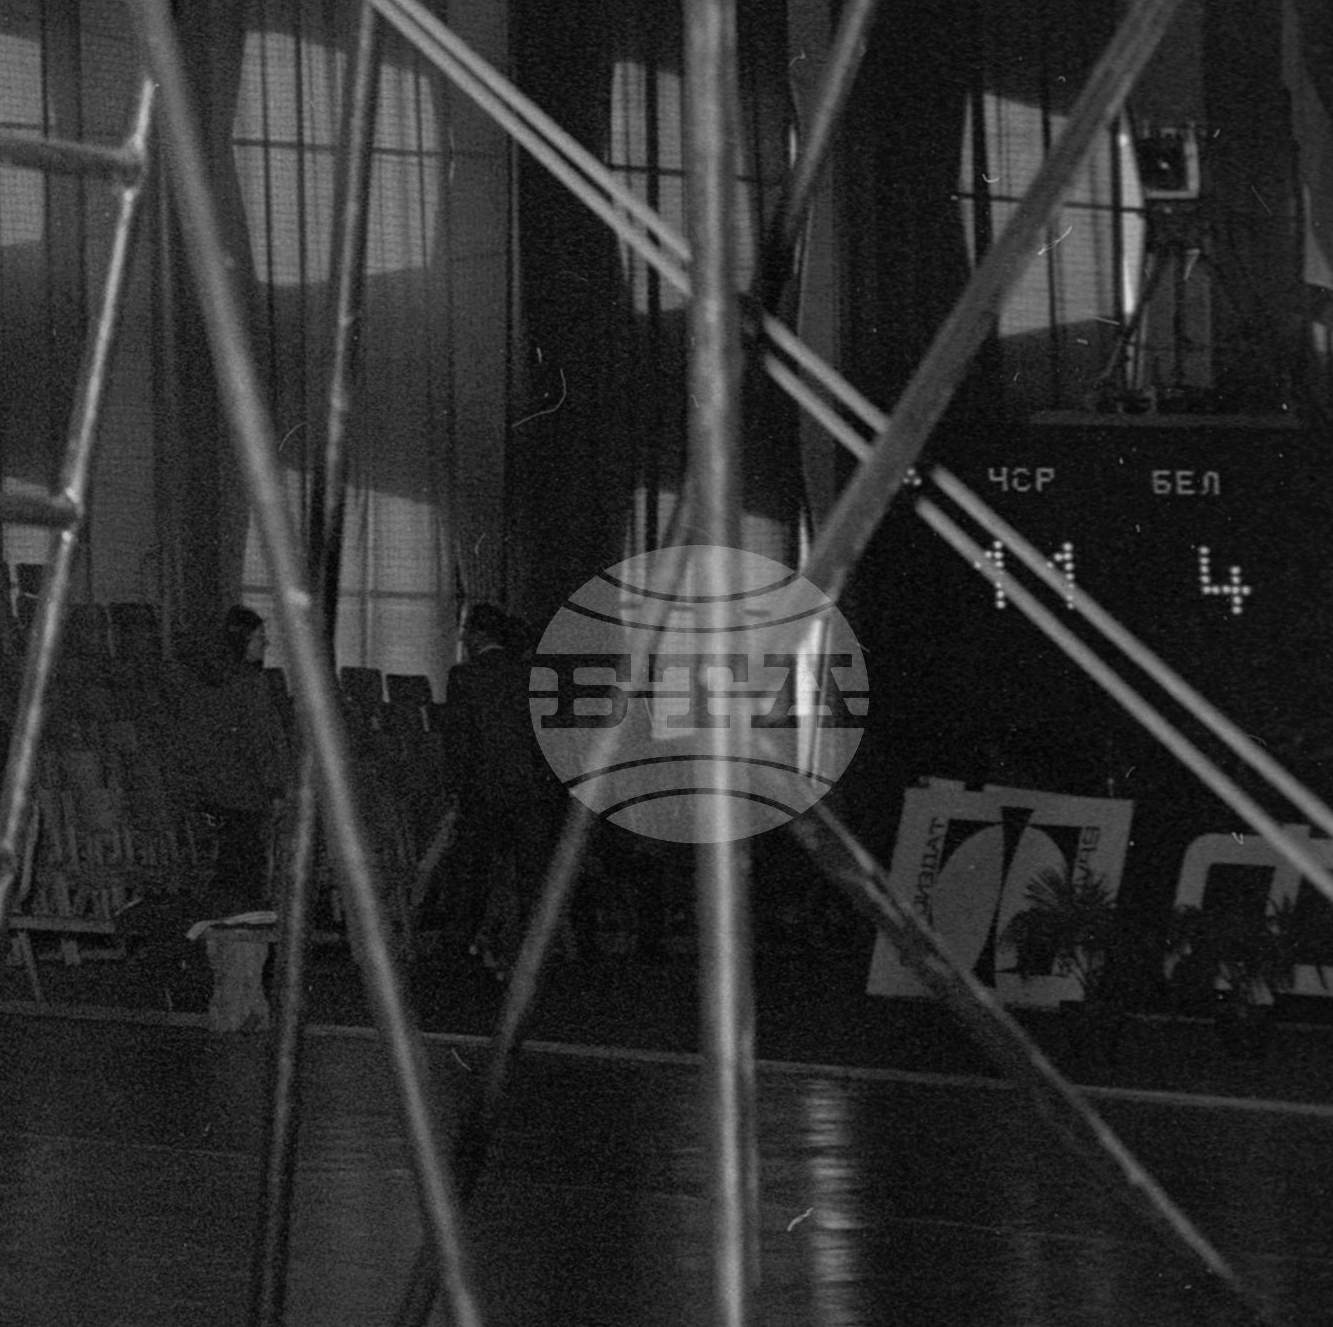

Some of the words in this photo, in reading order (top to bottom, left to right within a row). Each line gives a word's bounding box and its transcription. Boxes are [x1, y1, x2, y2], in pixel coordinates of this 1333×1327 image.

[988, 466, 1056, 493] ЧСР
[1151, 469, 1221, 496] БЕЛ
[1197, 545, 1251, 615] 4
